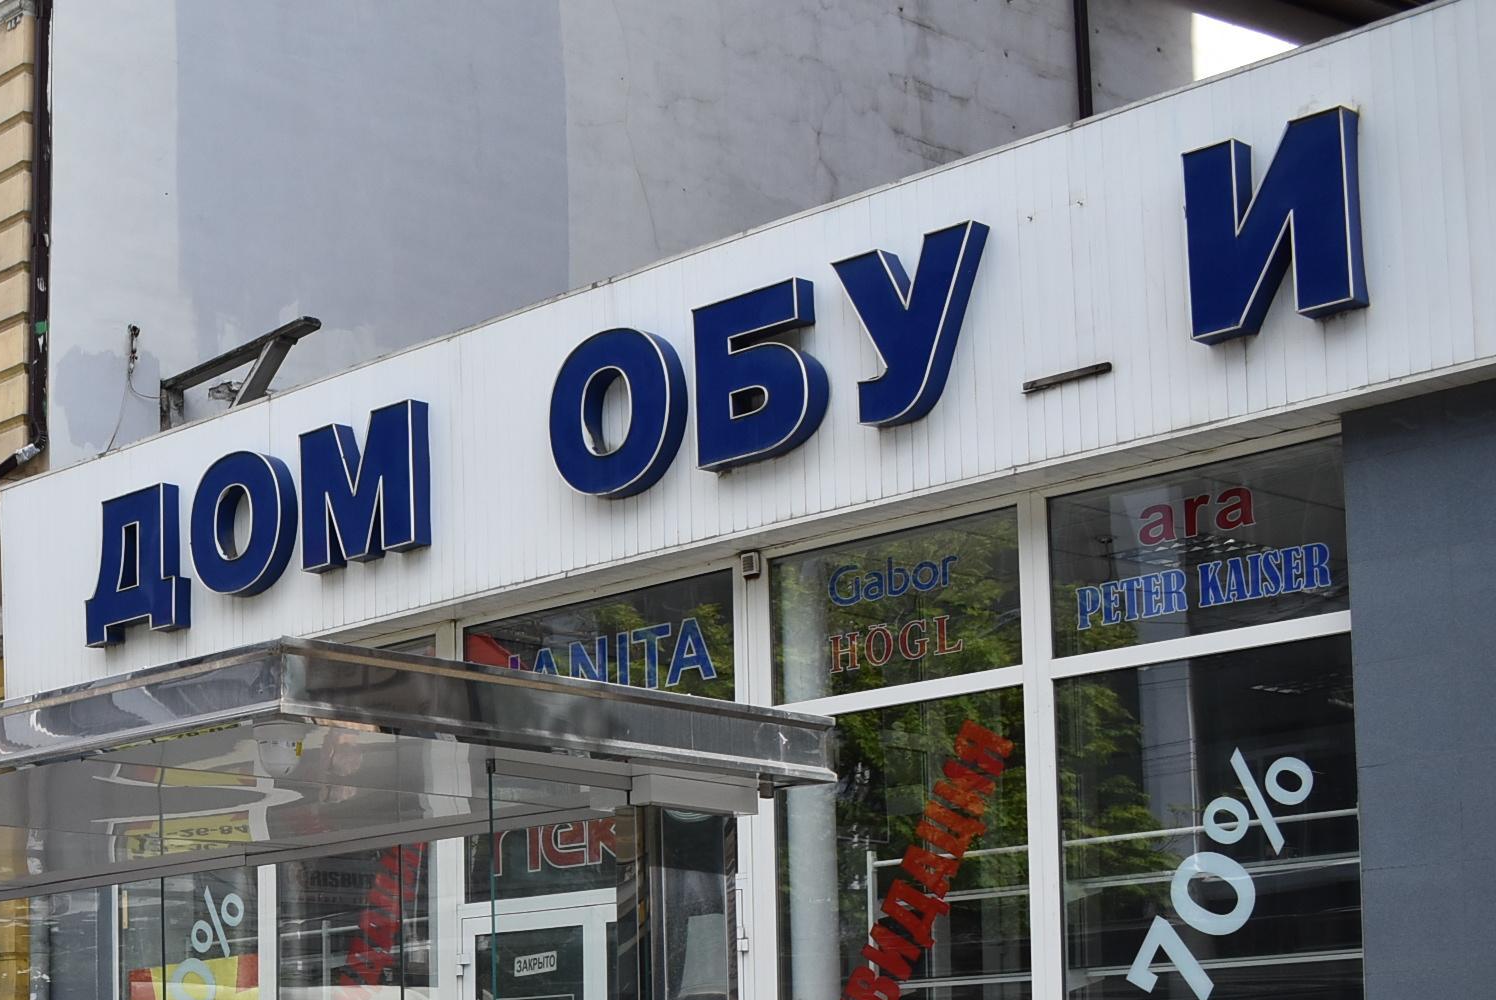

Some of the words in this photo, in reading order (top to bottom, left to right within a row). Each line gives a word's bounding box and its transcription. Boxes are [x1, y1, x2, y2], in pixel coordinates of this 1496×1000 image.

[86, 399, 432, 648] ДОМ
[1137, 485, 1255, 546] ara
[828, 555, 959, 607] Gabor
[1076, 568, 1188, 631] PETER
[1197, 542, 1331, 609] KAISER
[508, 617, 717, 690] NITA
[829, 615, 963, 674] HÖGL
[515, 954, 556, 973] ЗАКРЫТО
